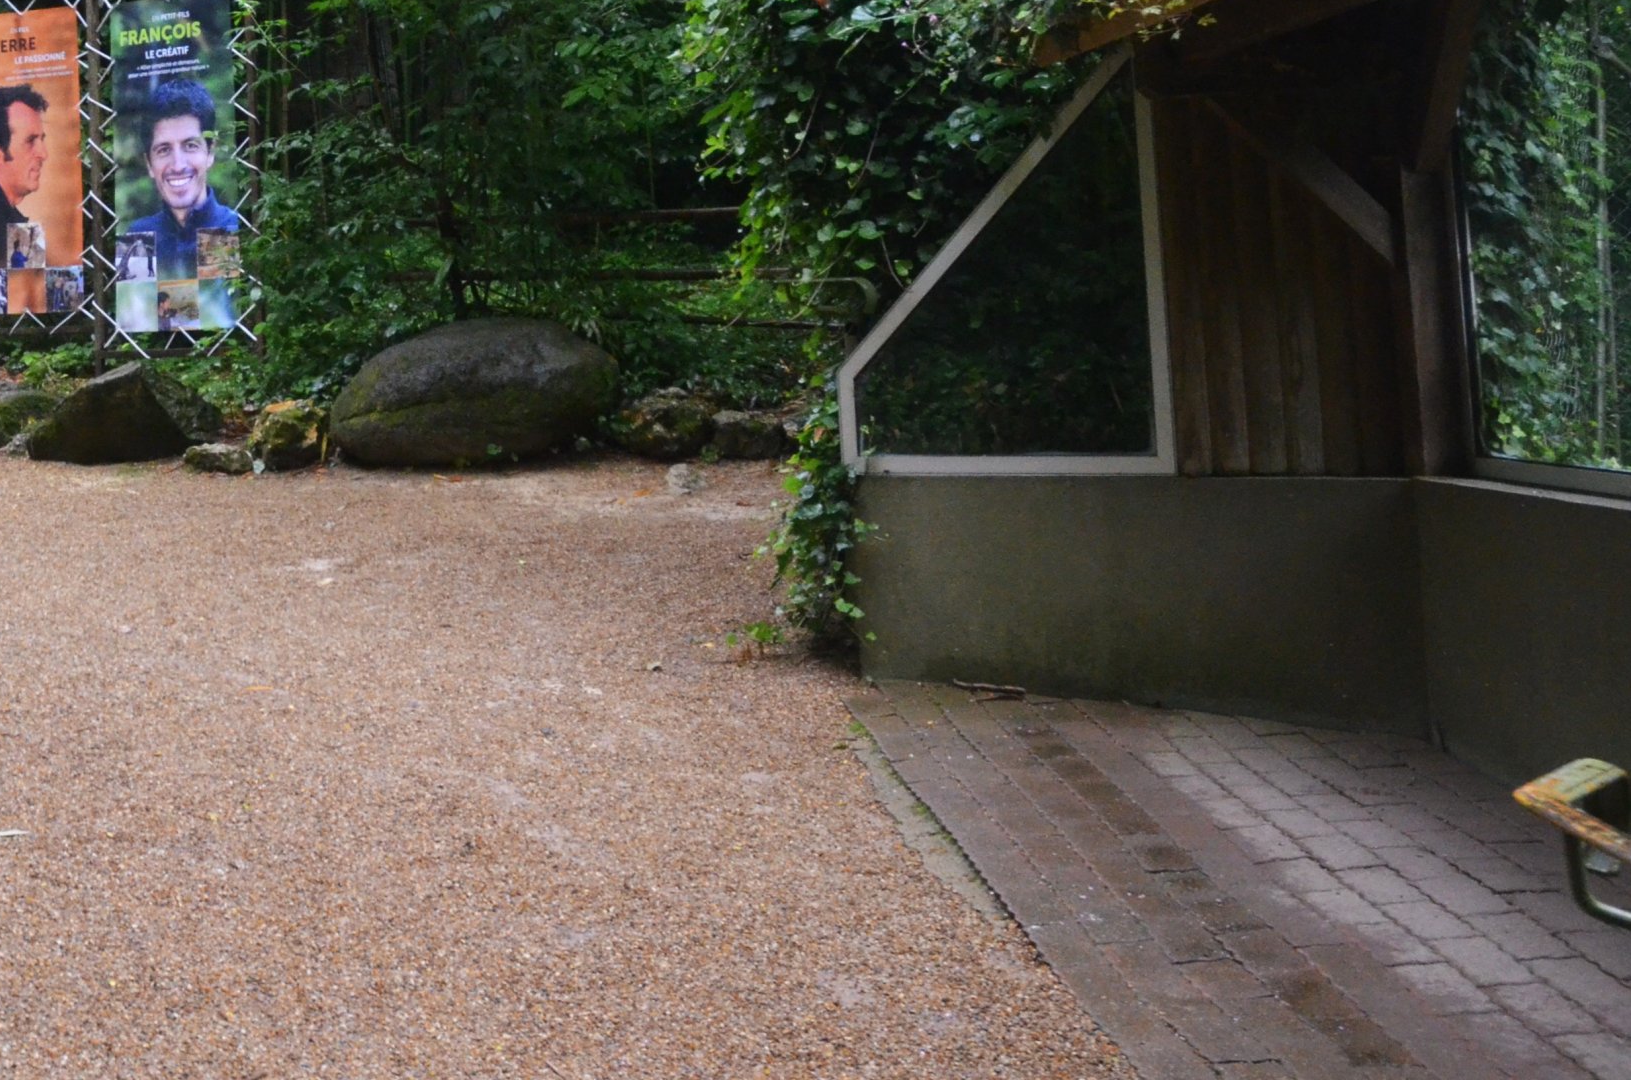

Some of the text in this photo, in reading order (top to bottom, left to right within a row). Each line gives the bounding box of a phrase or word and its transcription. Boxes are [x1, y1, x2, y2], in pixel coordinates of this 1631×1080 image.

[120, 21, 202, 47] FRANÇOIS
[14, 51, 66, 65] LE PASSIONNÉ
[145, 45, 189, 59] LE CRÉATIF
